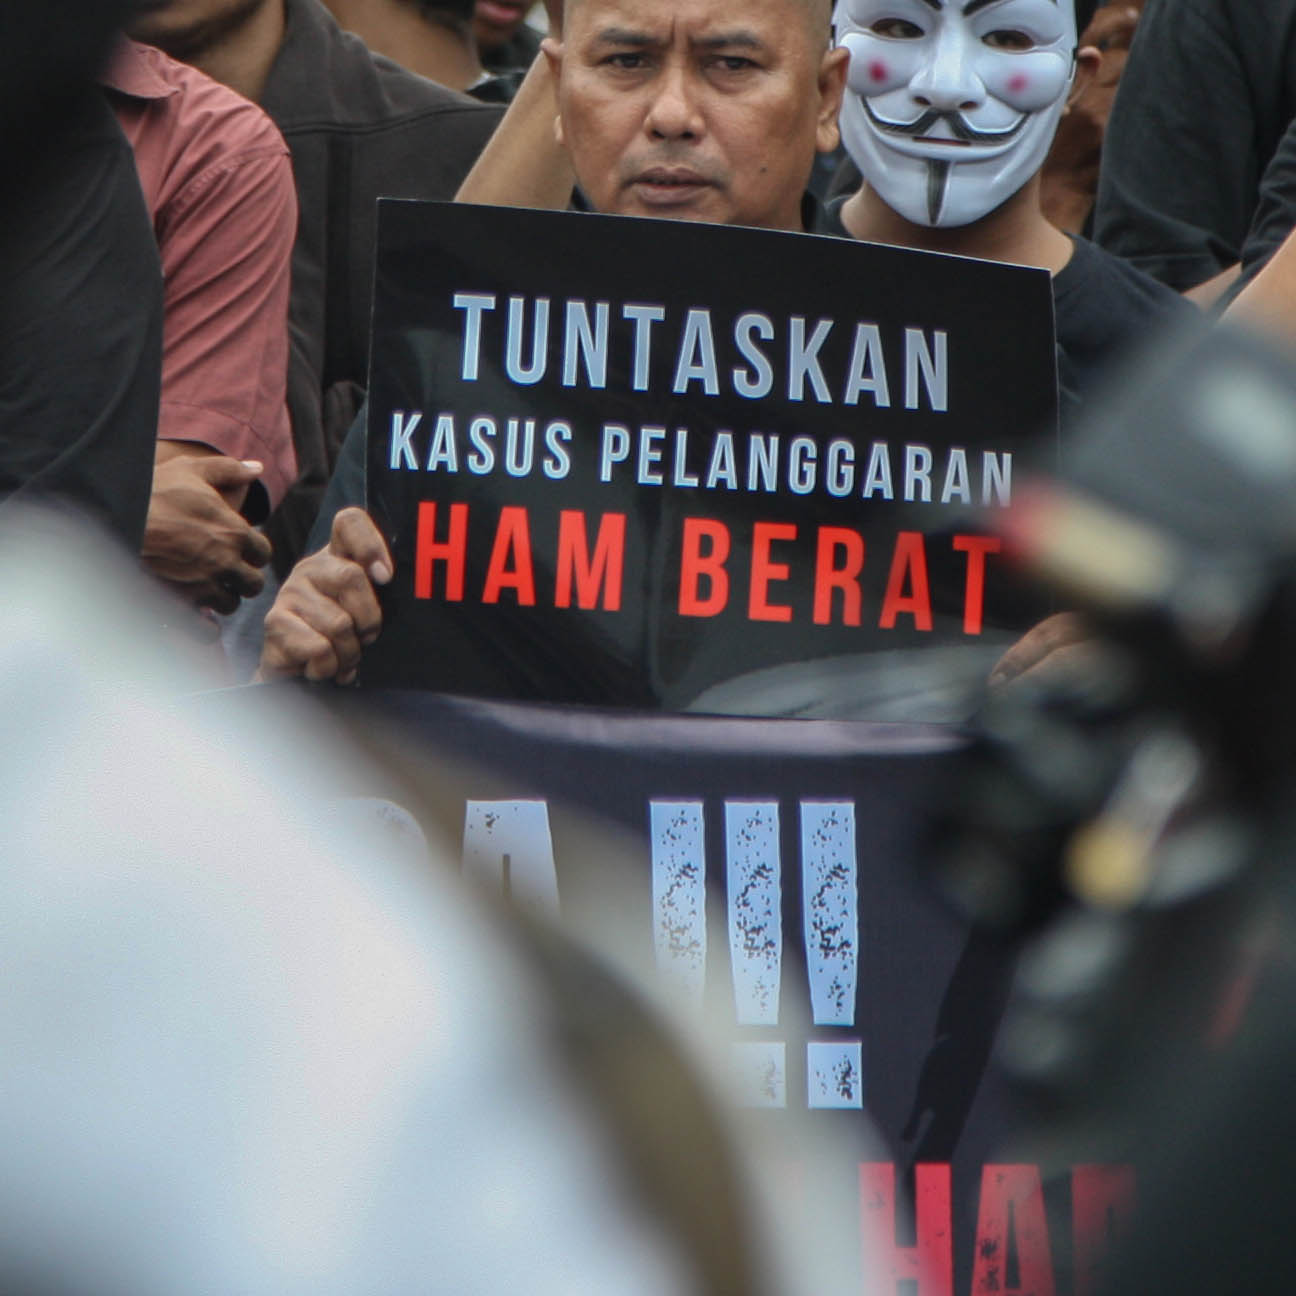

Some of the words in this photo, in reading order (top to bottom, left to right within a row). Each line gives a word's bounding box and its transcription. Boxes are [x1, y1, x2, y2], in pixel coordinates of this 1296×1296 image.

[453, 292, 949, 413] TUNTASKAN
[389, 410, 574, 480] KASUS
[599, 424, 1014, 508] PELANGGARAN
[414, 501, 626, 613] HAM
[677, 516, 1002, 636] BERAT
